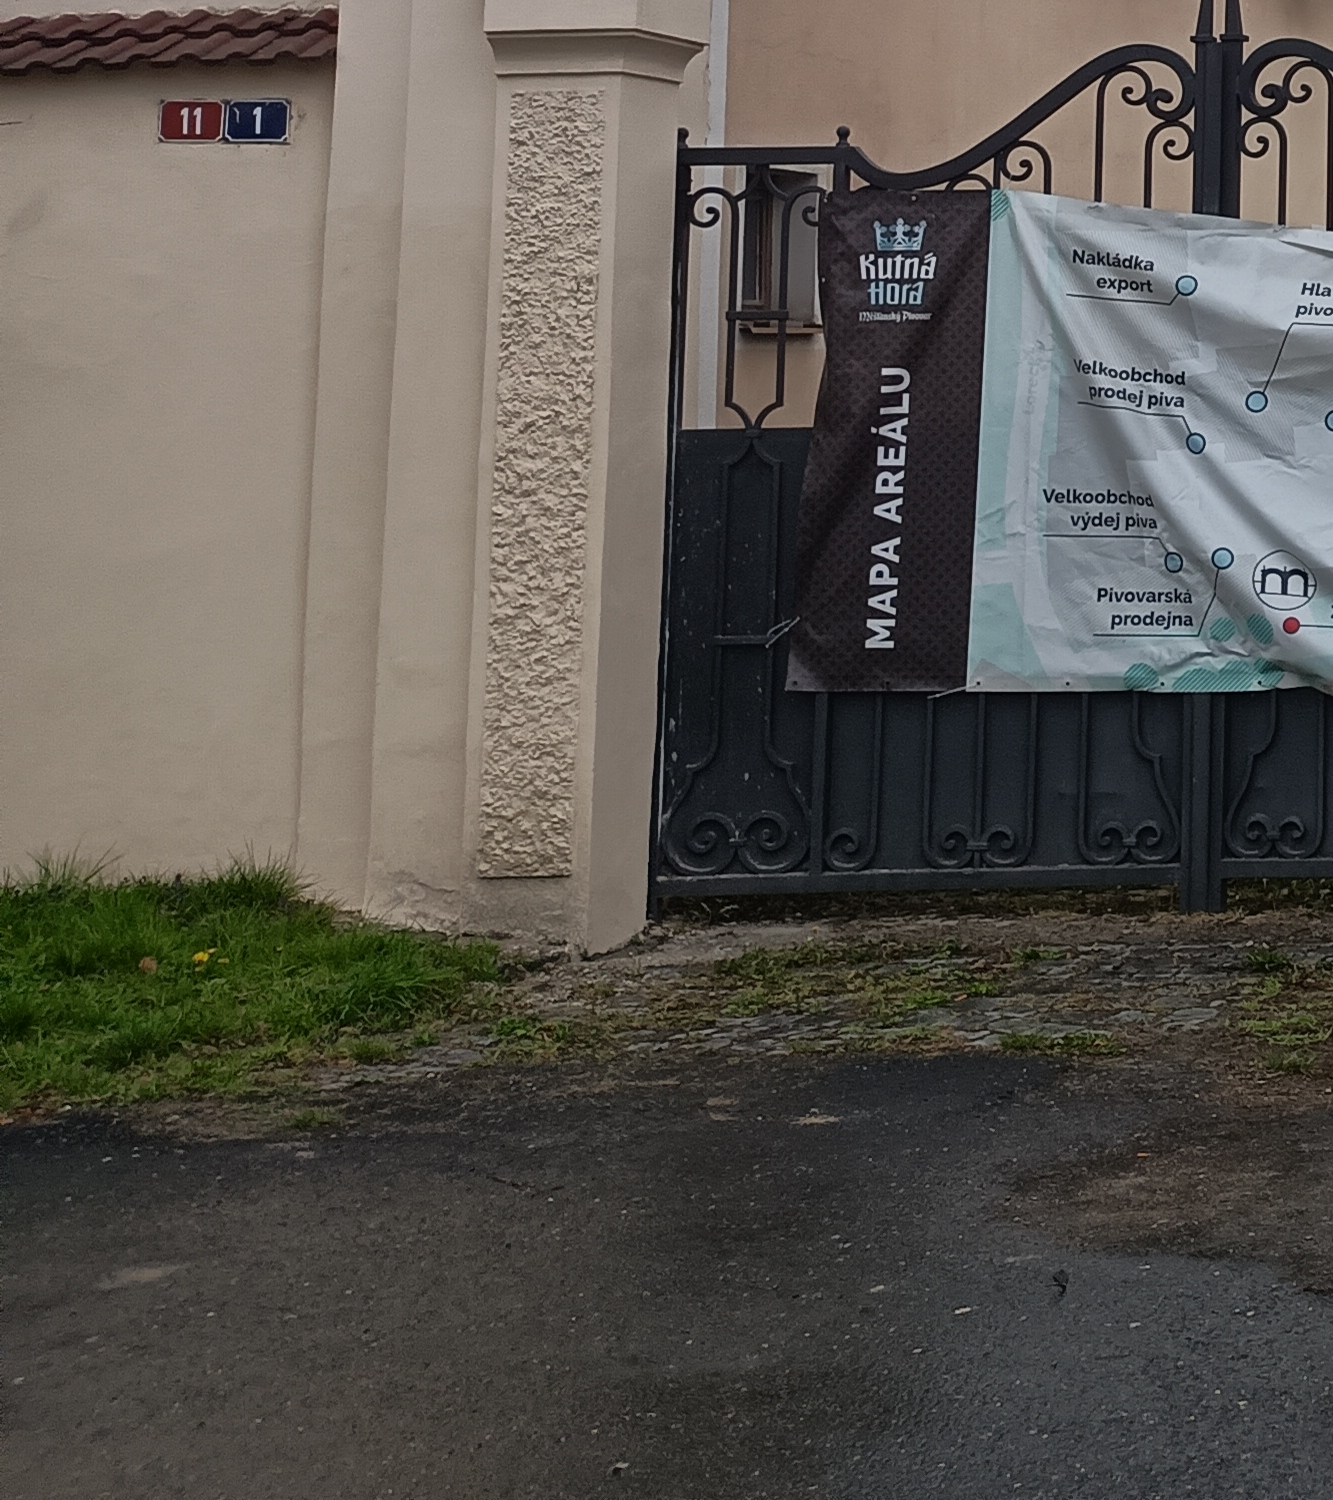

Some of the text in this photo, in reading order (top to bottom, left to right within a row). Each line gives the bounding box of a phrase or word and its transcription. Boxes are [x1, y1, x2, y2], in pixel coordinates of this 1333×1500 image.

[180, 107, 202, 135] 11
[252, 106, 262, 135] 1
[859, 252, 937, 280] Kutná
[1072, 249, 1155, 272] Nakládka
[867, 281, 924, 305] Hora
[1096, 276, 1153, 294] export
[1073, 358, 1186, 385] Velkoobchod
[1088, 385, 1185, 410] prodej piva
[865, 367, 911, 649] MAPA AREÁLU
[1042, 488, 1155, 508] Velkoobchod
[1070, 511, 1158, 531] výdej piva
[1096, 587, 1193, 604] Pivovarská
[1110, 611, 1194, 630] prodejna
